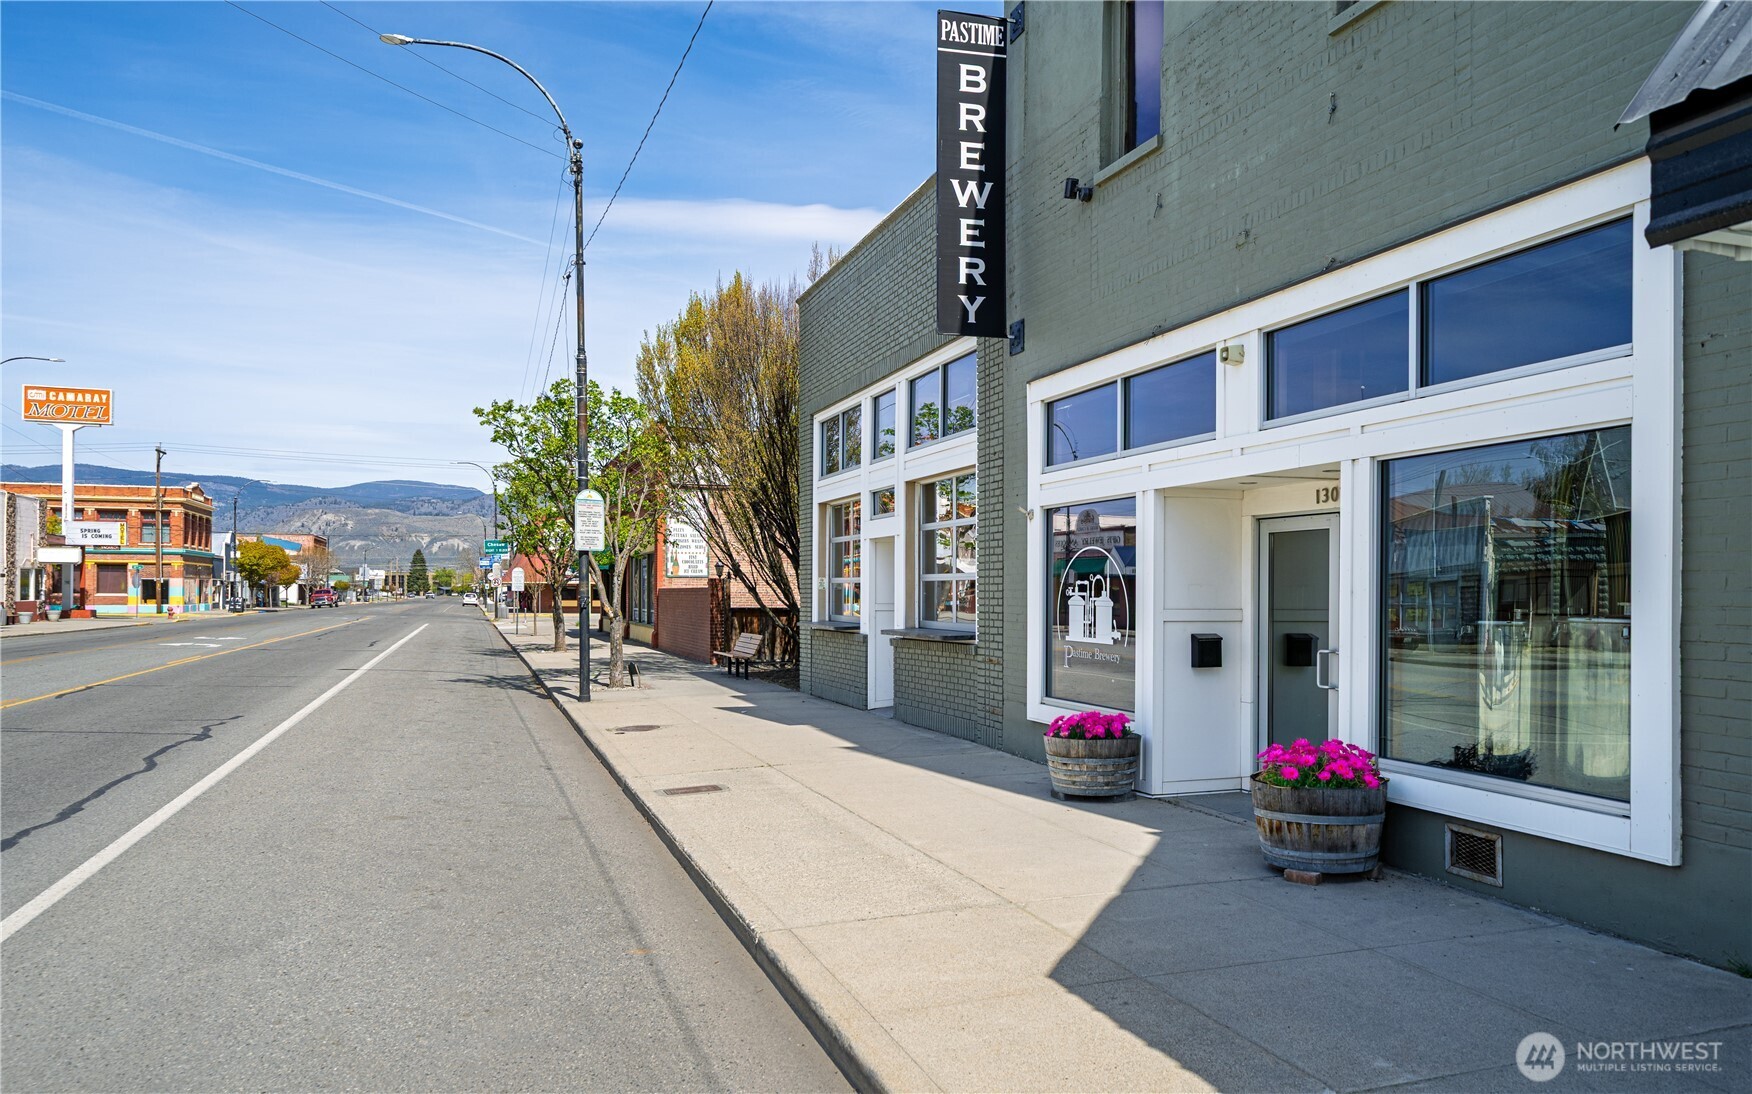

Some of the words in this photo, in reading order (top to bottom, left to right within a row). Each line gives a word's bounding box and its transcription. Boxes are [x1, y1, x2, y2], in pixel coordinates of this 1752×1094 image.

[941, 19, 1005, 47] PASTIME
[950, 63, 994, 324] BREWERY
[49, 391, 108, 403] CAMARAY
[24, 402, 109, 420] MOTEL
[1315, 486, 1339, 504] 130
[1063, 645, 1093, 668] Pastime
[1094, 648, 1120, 664] Brewery
